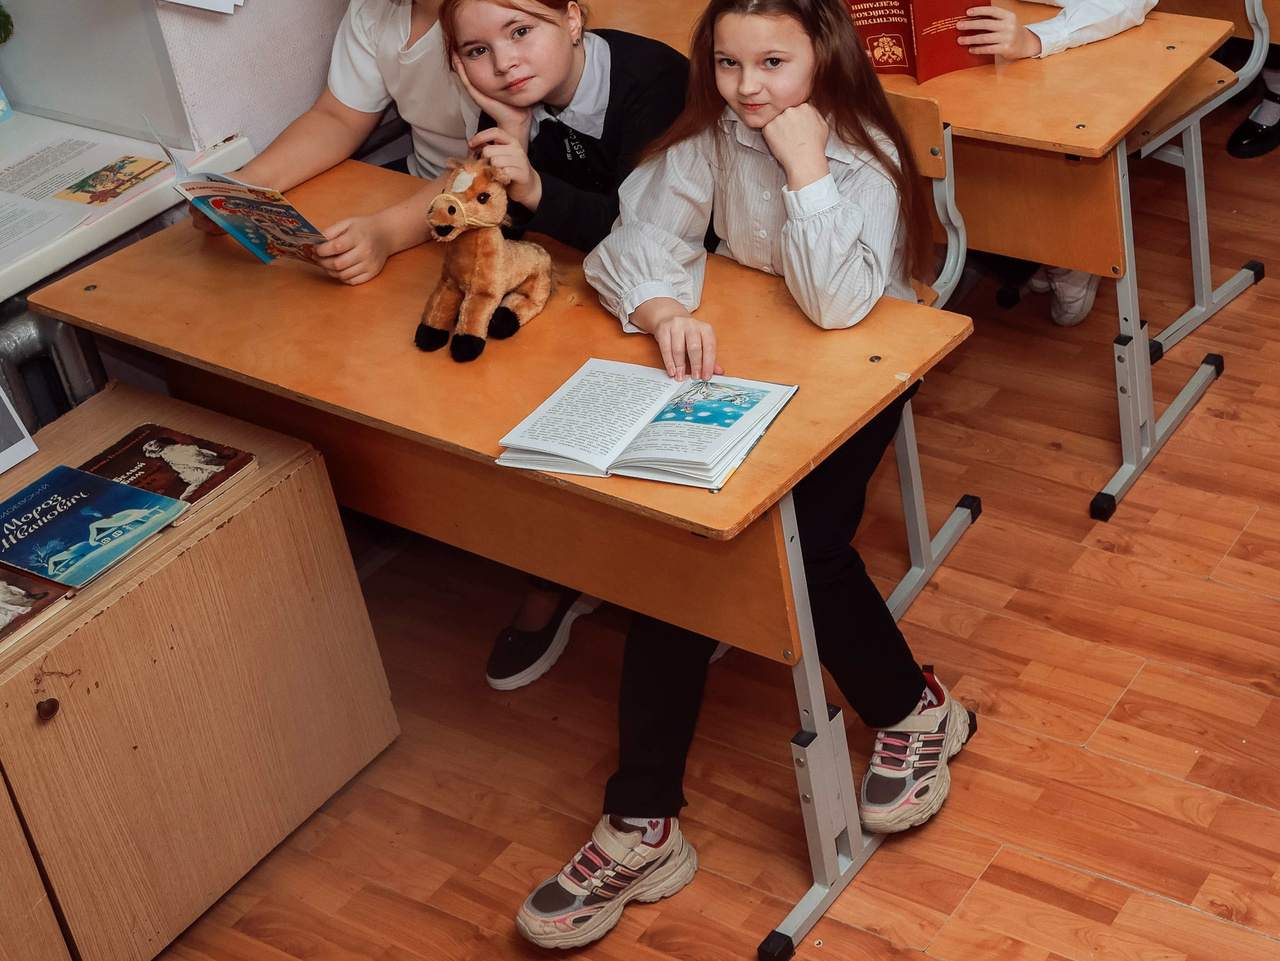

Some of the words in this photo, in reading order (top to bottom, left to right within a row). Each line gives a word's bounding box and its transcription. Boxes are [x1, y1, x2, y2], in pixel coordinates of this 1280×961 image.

[851, 1, 900, 11] ФЕДЕРАЦИИ
[851, 9, 905, 20] РОССИЙСКОЙ
[3, 493, 63, 536] Мороз
